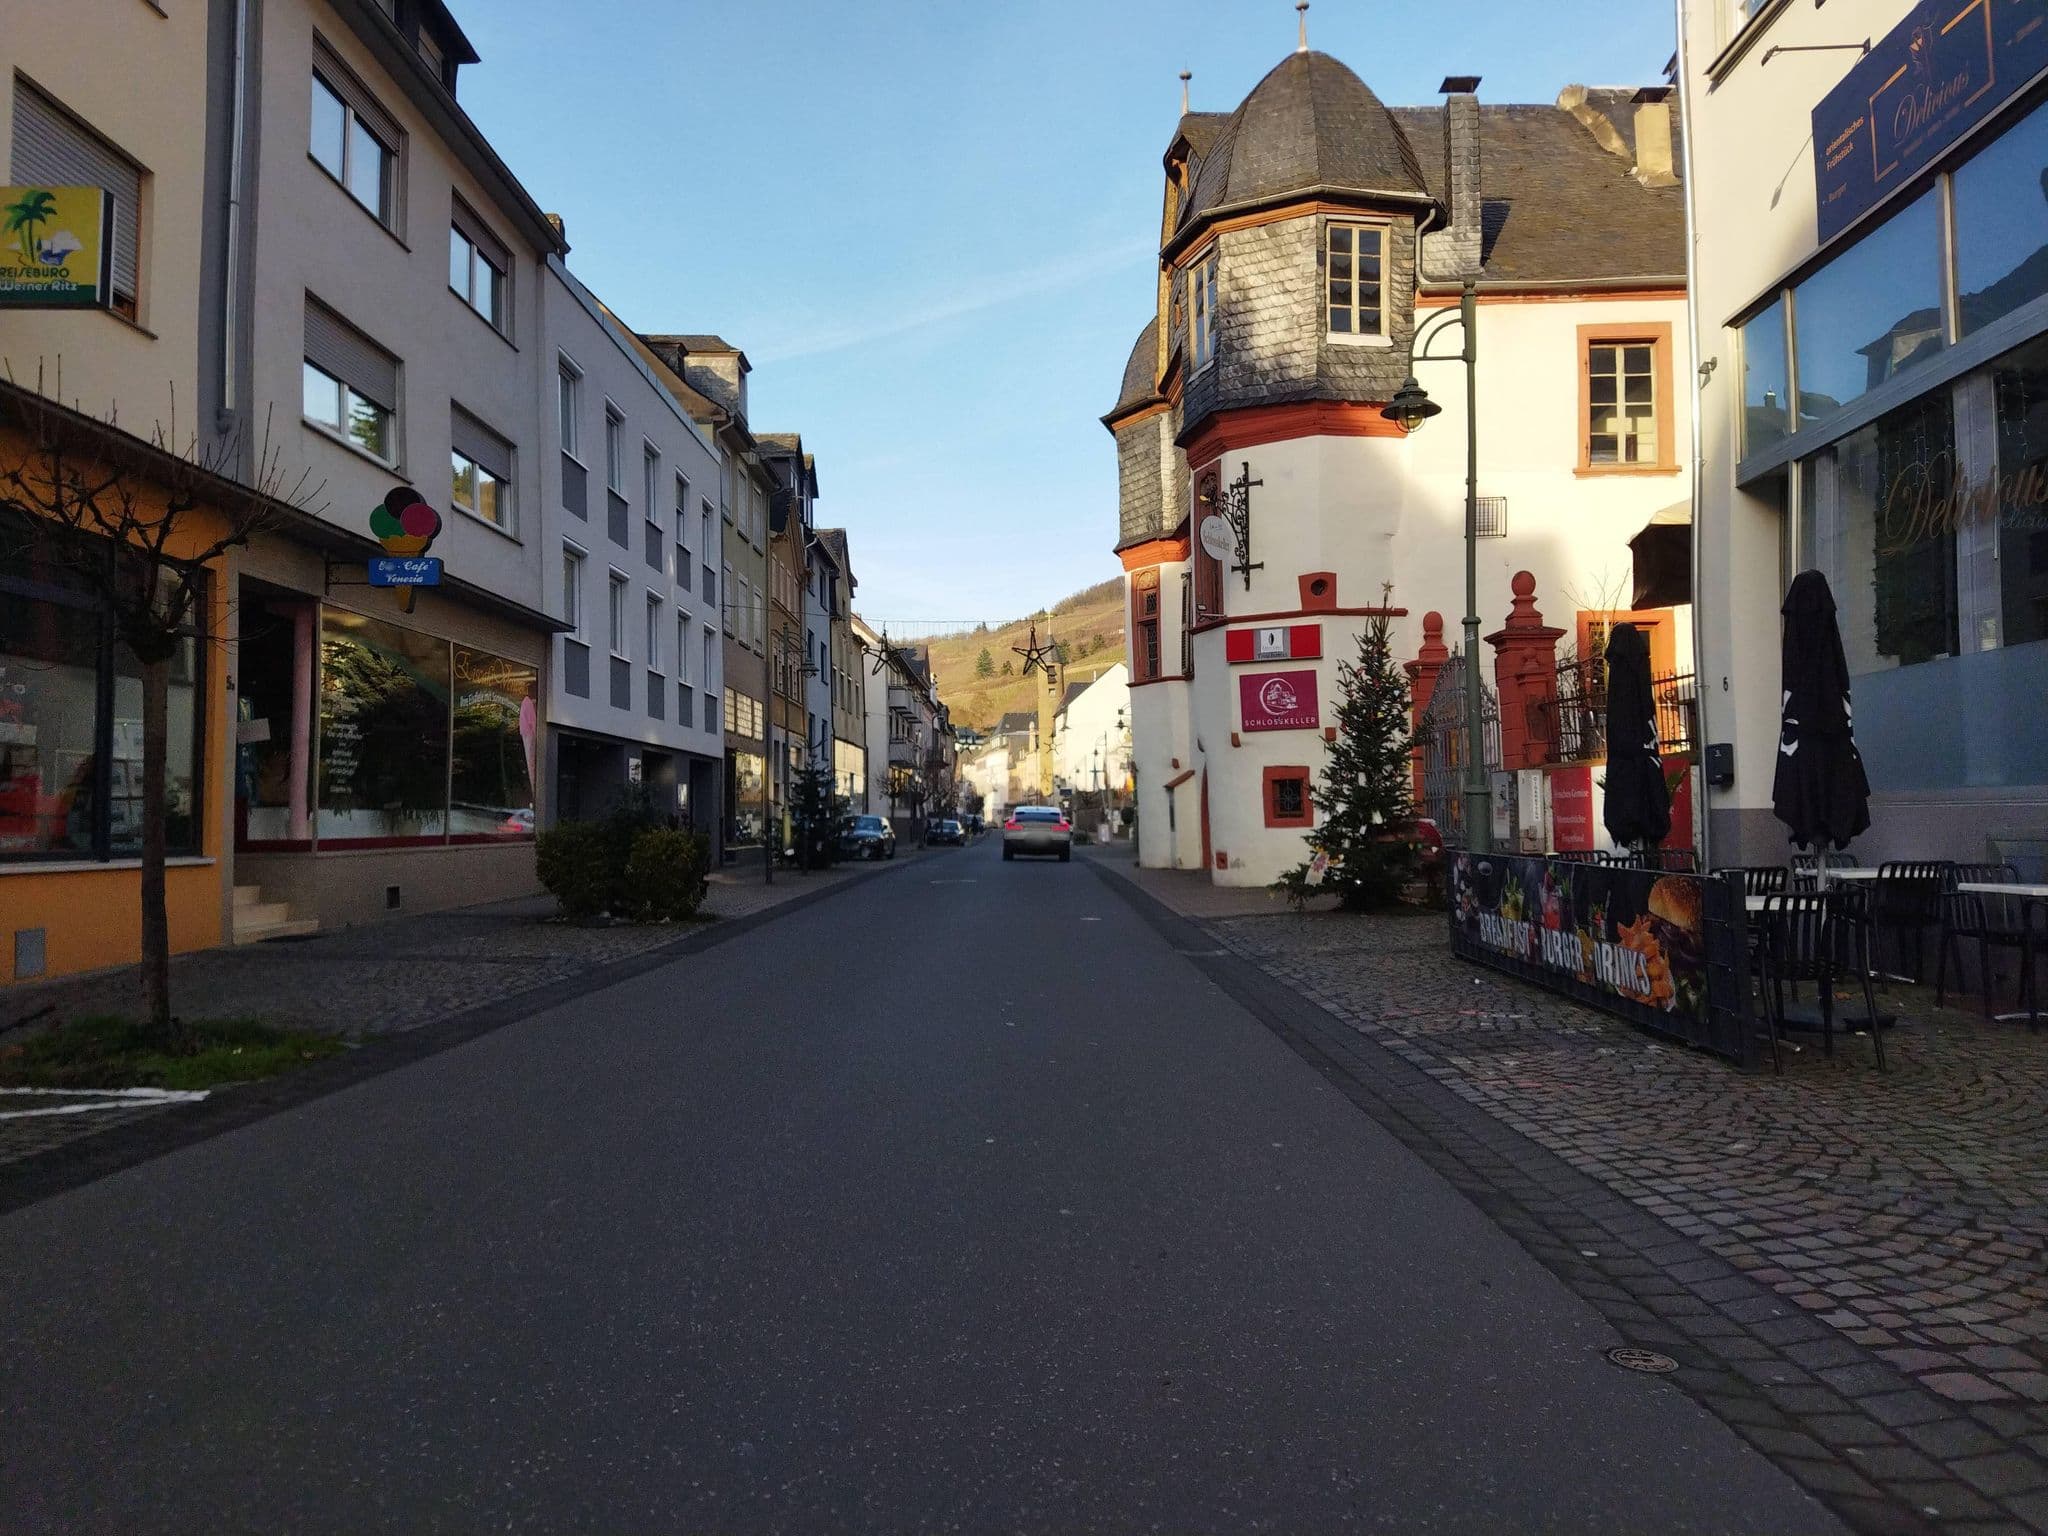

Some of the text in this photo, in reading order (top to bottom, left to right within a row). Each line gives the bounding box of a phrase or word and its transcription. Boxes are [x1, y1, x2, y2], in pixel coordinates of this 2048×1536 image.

[51, 280, 78, 291] Ritz
[1723, 676, 1729, 691] 6
[1244, 716, 1316, 727] SCHLOSSKELLER
[1479, 911, 1651, 996] BREAKFAST BURGER DRINKS
